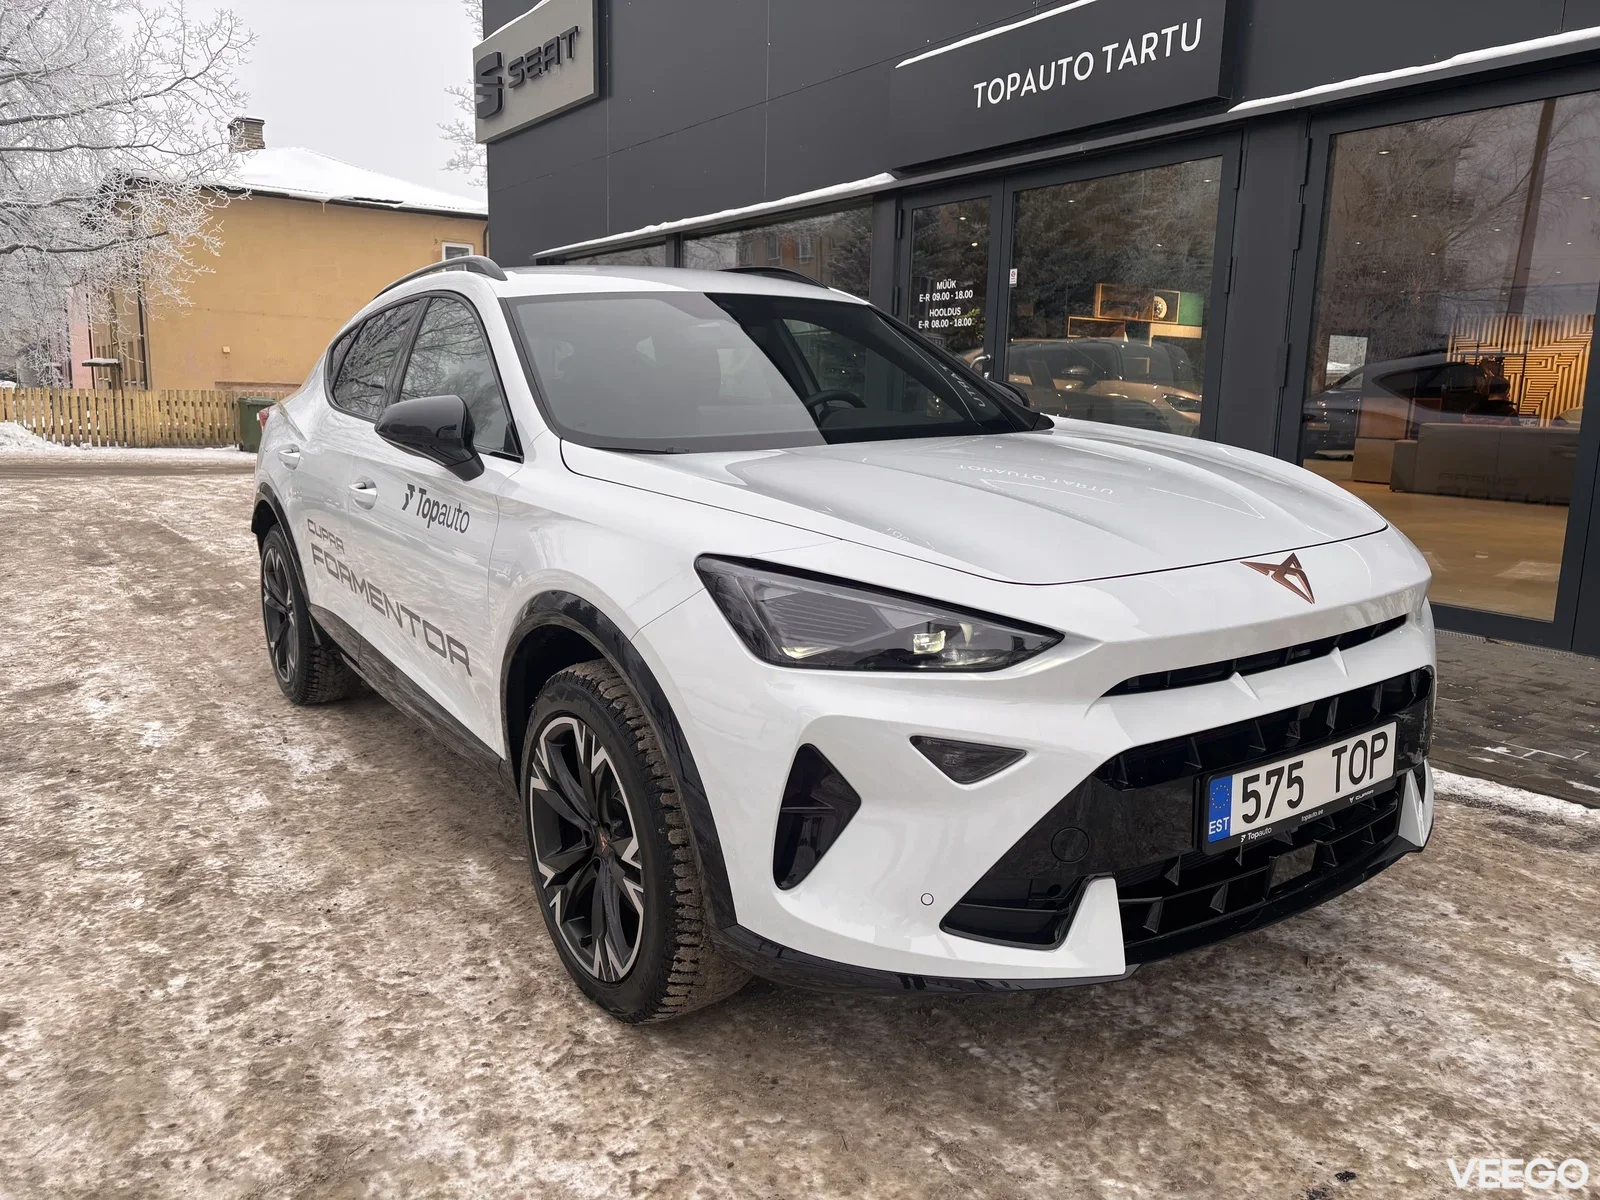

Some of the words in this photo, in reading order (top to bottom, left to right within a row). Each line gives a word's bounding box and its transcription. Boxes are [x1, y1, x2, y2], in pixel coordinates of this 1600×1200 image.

[508, 25, 579, 89] SEAT
[973, 51, 1094, 108] TOPAUTO
[1102, 18, 1202, 73] TARTU
[936, 279, 957, 290] MÜÜK
[919, 293, 930, 302] E-R
[932, 291, 950, 301] 09.00
[954, 289, 973, 300] 18.00
[929, 307, 961, 317] HOOLDUS
[918, 320, 929, 329] E-R
[931, 318, 949, 328] 08.00
[954, 317, 972, 327] 18.00
[416, 487, 470, 534] Topauto
[307, 518, 345, 555] CUPRA
[310, 542, 473, 678] FORMENTOR
[1242, 759, 1305, 824] 575
[1332, 731, 1388, 794] TOP
[1301, 809, 1324, 822] topauto.ee
[1208, 816, 1230, 835] EST
[1247, 827, 1273, 841] Topauto
